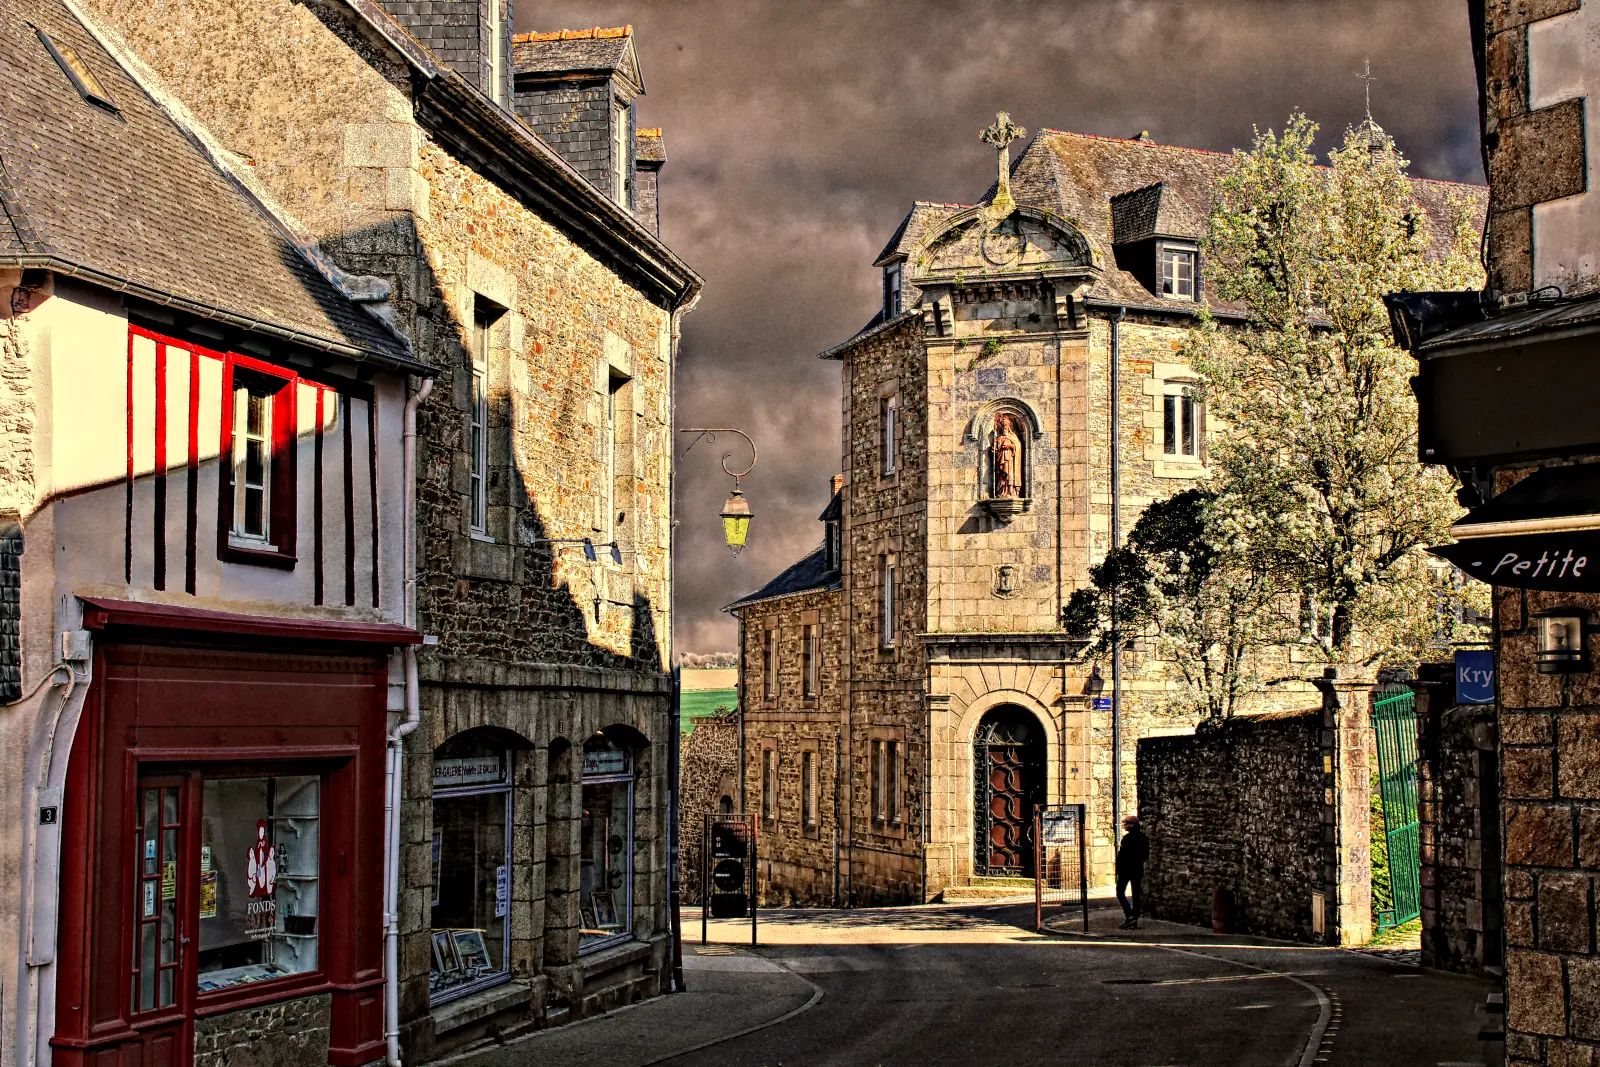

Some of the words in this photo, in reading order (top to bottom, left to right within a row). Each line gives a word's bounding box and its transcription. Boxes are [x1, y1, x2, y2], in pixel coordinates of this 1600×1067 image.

[1490, 549, 1588, 578] Petite
[1459, 667, 1494, 688] Kry
[46, 810, 52, 821] 3
[247, 900, 276, 914] FONDS
